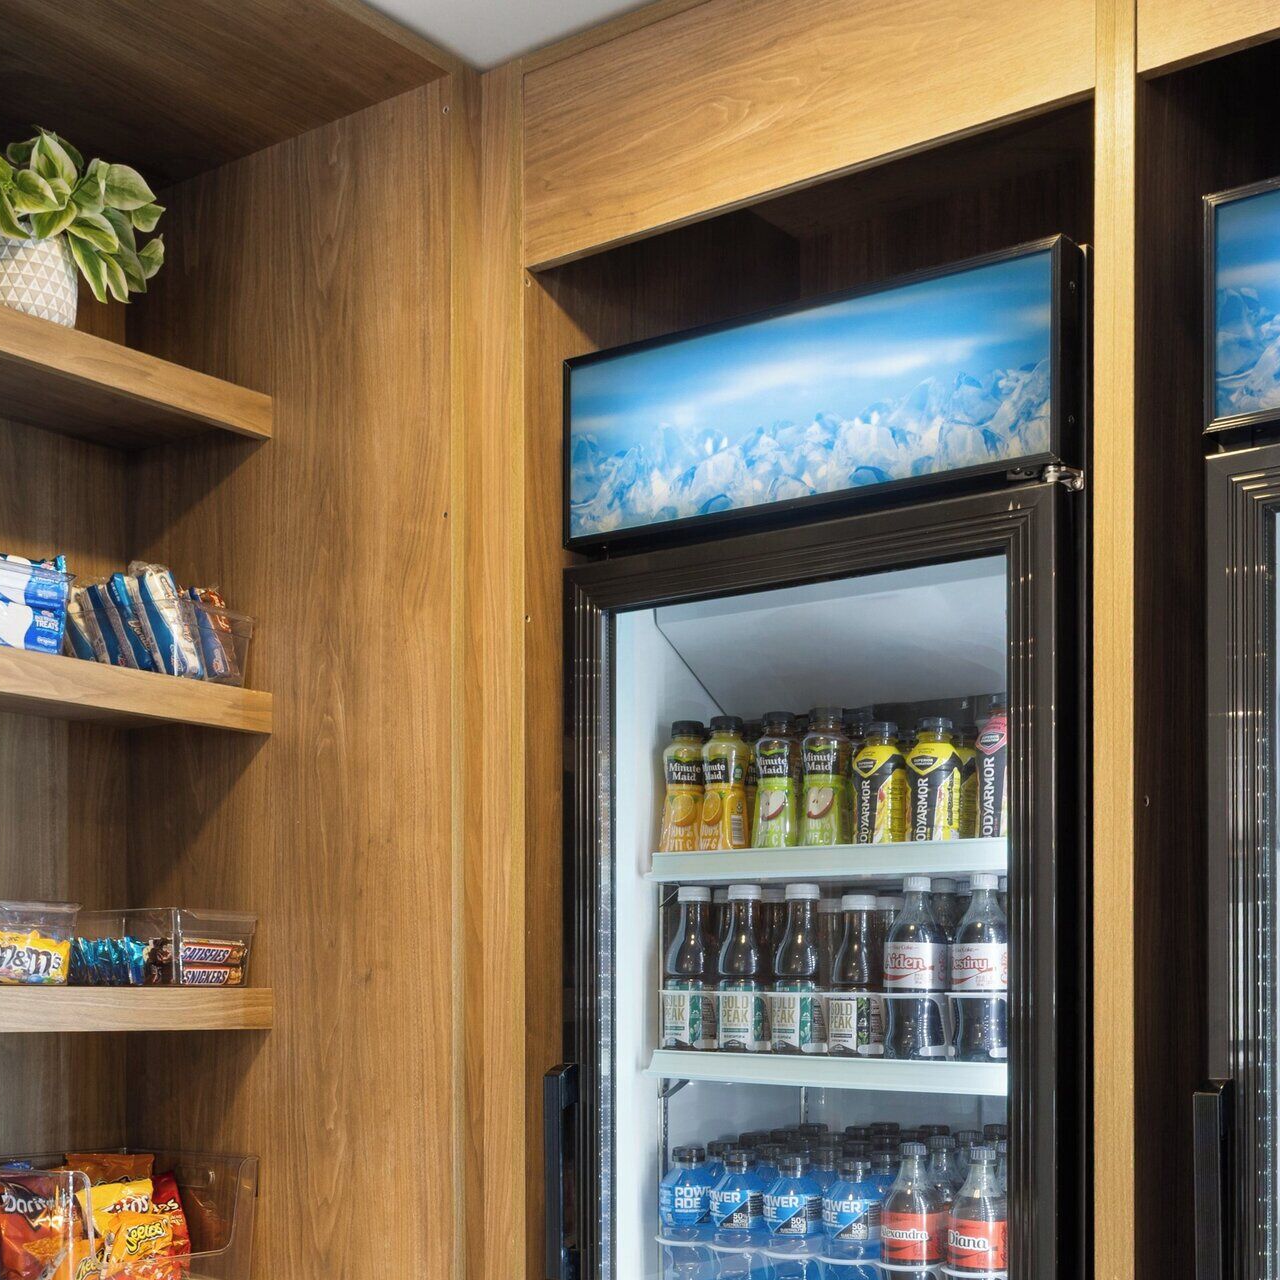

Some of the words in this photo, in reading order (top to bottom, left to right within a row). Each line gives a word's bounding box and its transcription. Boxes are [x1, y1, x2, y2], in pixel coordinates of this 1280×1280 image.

[35, 620, 59, 631] TREATS
[669, 762, 701, 773] Minute
[760, 764, 783, 774] Maid
[807, 761, 831, 771] Maid
[672, 771, 696, 781] Maid
[859, 780, 871, 844] ODYARMOR
[181, 946, 230, 961] SATISFIES
[884, 953, 925, 970] Aiden
[952, 955, 988, 972] estiny
[183, 970, 228, 984] SNICKERS
[722, 995, 749, 1007] GOLD
[830, 1001, 852, 1015] GOLD
[722, 1008, 749, 1023] PEAK
[830, 1016, 852, 1029] PEAK
[675, 1197, 701, 1209] ADE
[949, 1231, 987, 1249] Diana
